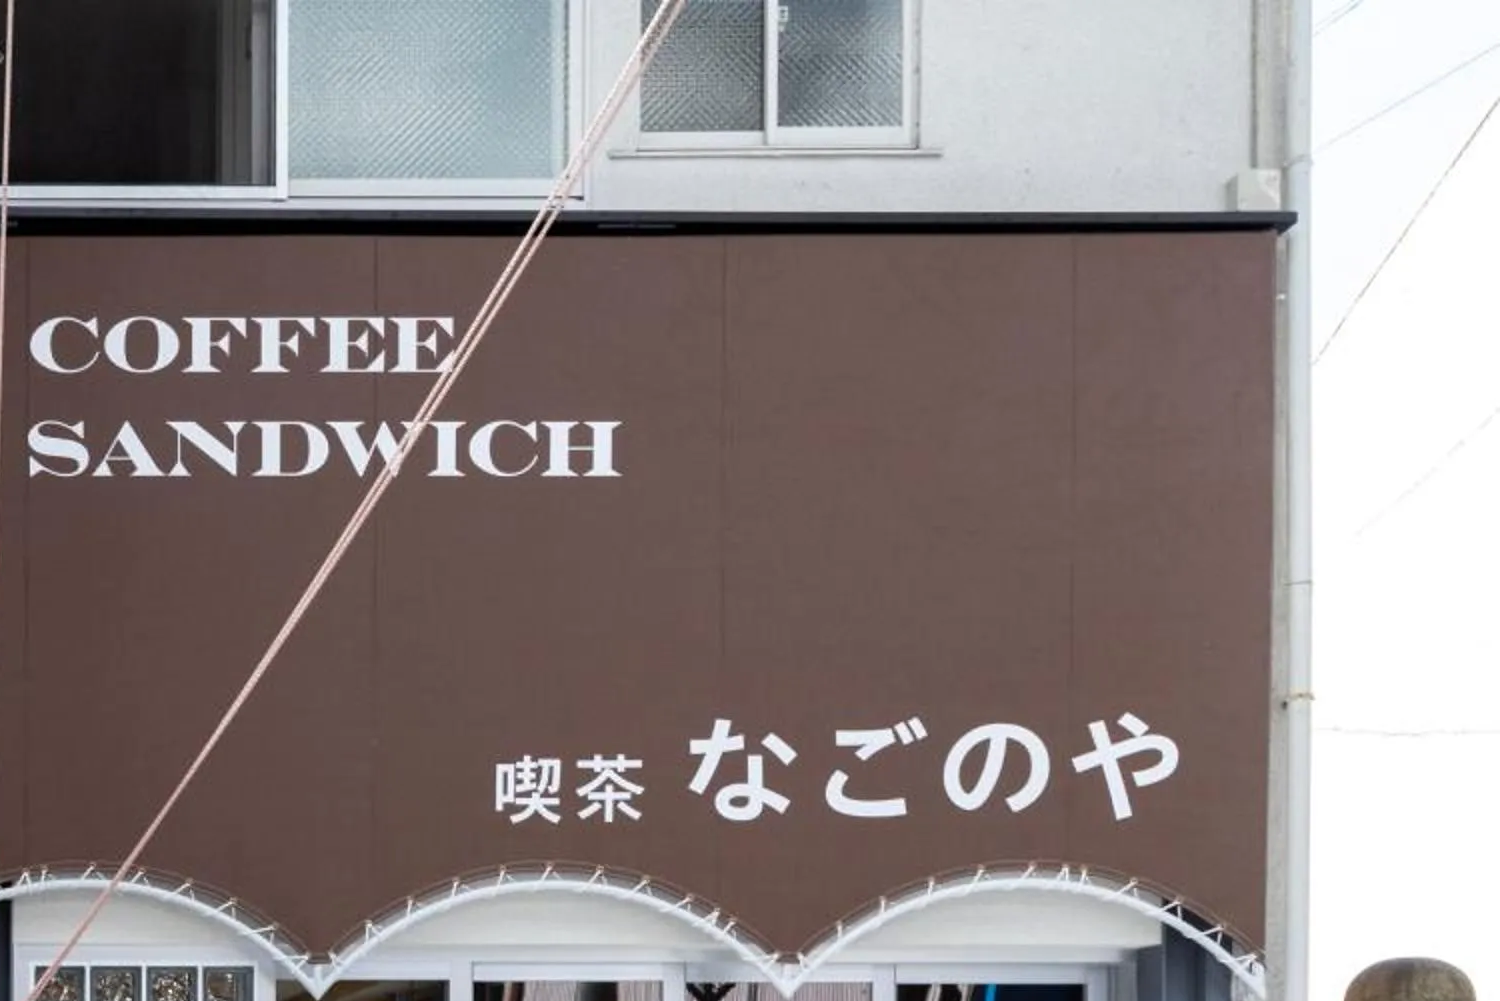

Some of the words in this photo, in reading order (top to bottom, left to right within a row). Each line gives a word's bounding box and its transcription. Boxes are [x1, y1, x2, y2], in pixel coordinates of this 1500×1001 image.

[29, 315, 455, 374] COFFEE
[27, 418, 623, 479] SANDWICH
[495, 752, 646, 825] 喫茶
[688, 710, 1181, 823] なごのや
